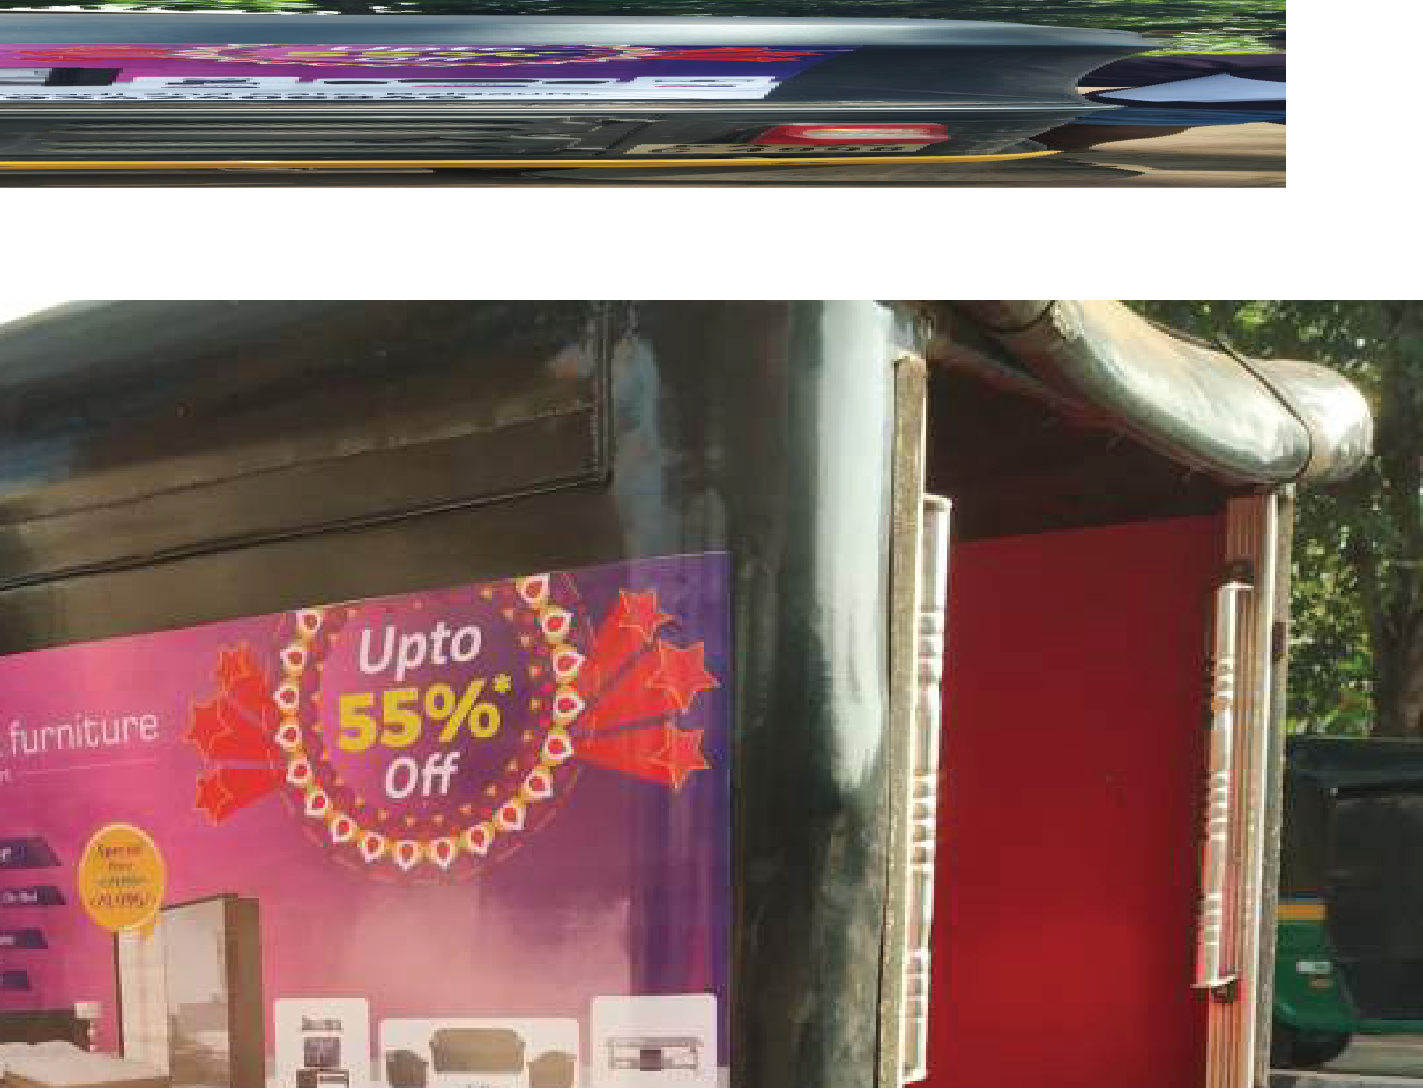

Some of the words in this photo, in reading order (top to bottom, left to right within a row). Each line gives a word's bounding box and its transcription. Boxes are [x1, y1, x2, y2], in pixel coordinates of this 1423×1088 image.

[359, 619, 482, 681] Upto
[8, 710, 160, 756] furniture
[384, 750, 462, 799] Off
